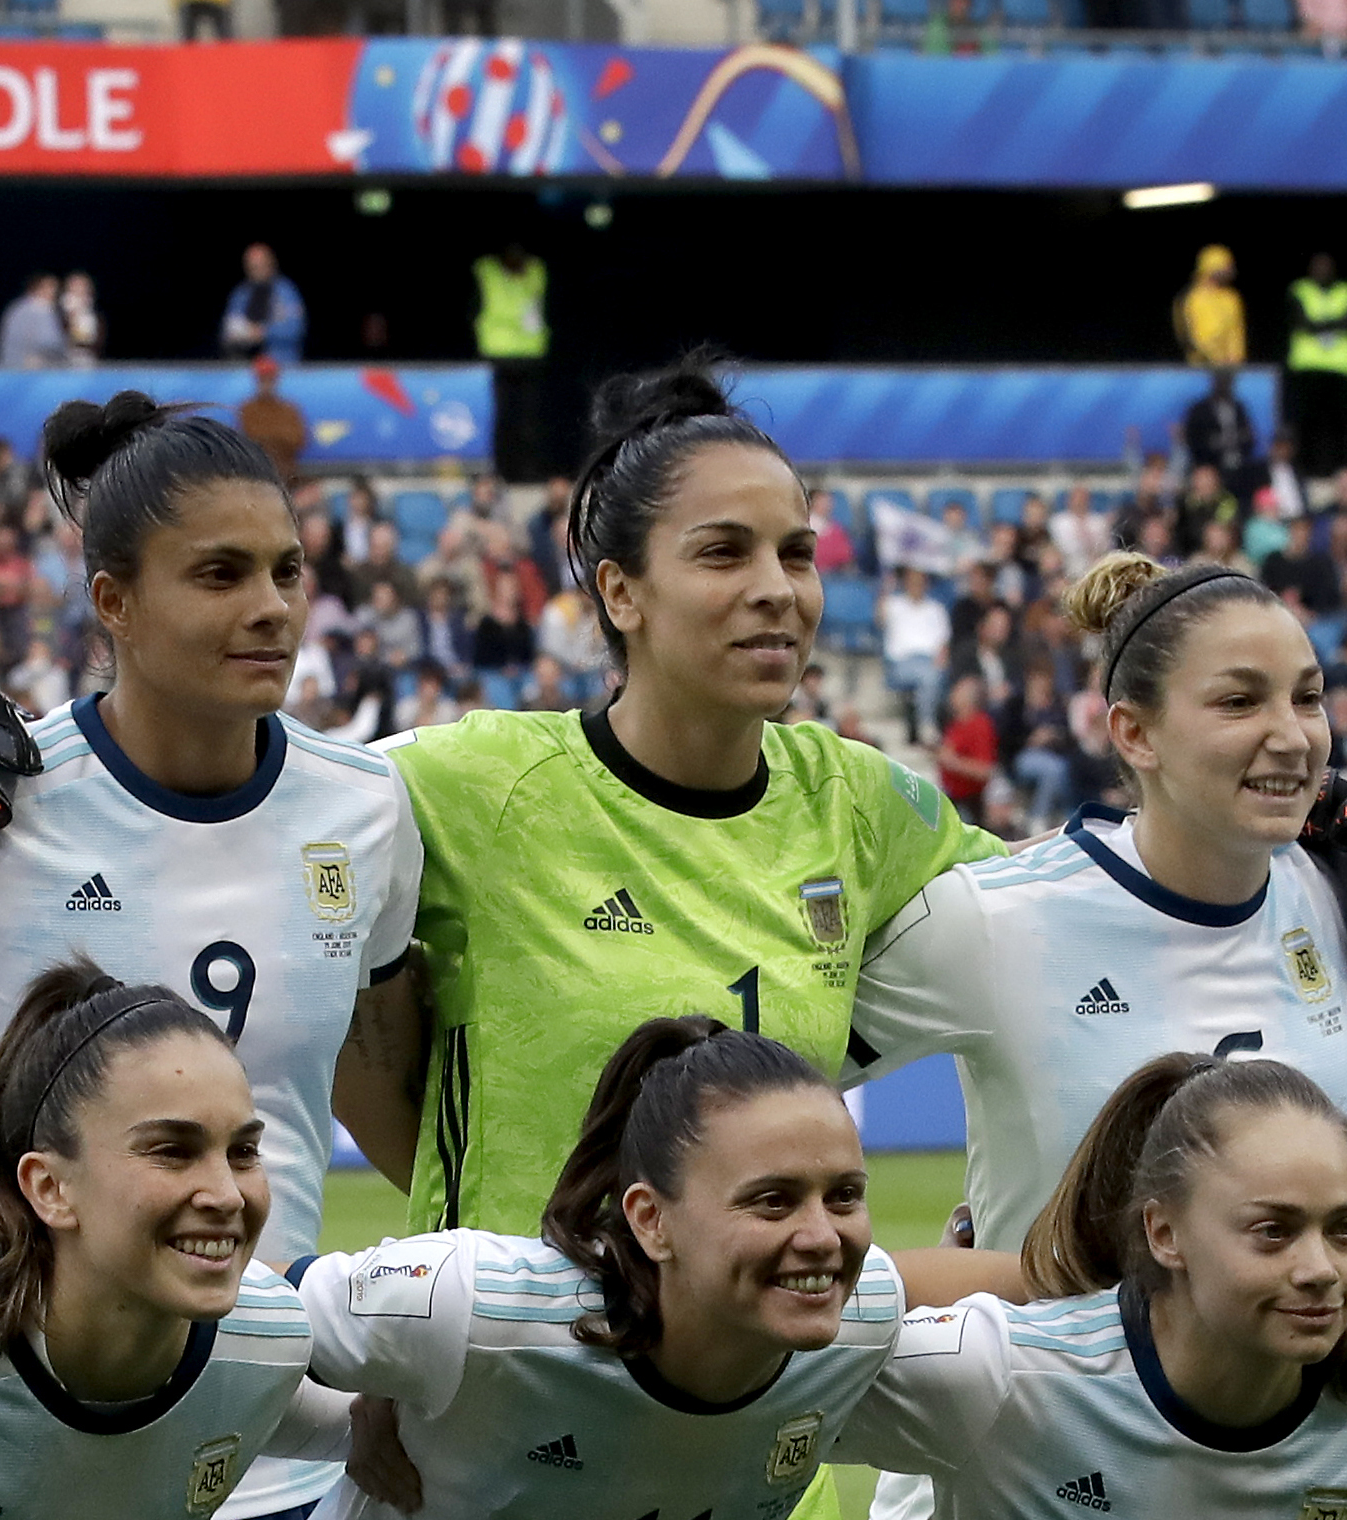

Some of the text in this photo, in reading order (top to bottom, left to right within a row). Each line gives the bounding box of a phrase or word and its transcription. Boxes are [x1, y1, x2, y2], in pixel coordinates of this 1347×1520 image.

[66, 897, 121, 912] adidas
[583, 916, 654, 934] adidas
[190, 940, 256, 1043] 9
[727, 965, 760, 1032] 1
[1075, 1001, 1130, 1015] adidas
[527, 1449, 584, 1470] adidas
[1056, 1485, 1111, 1512] adidas
